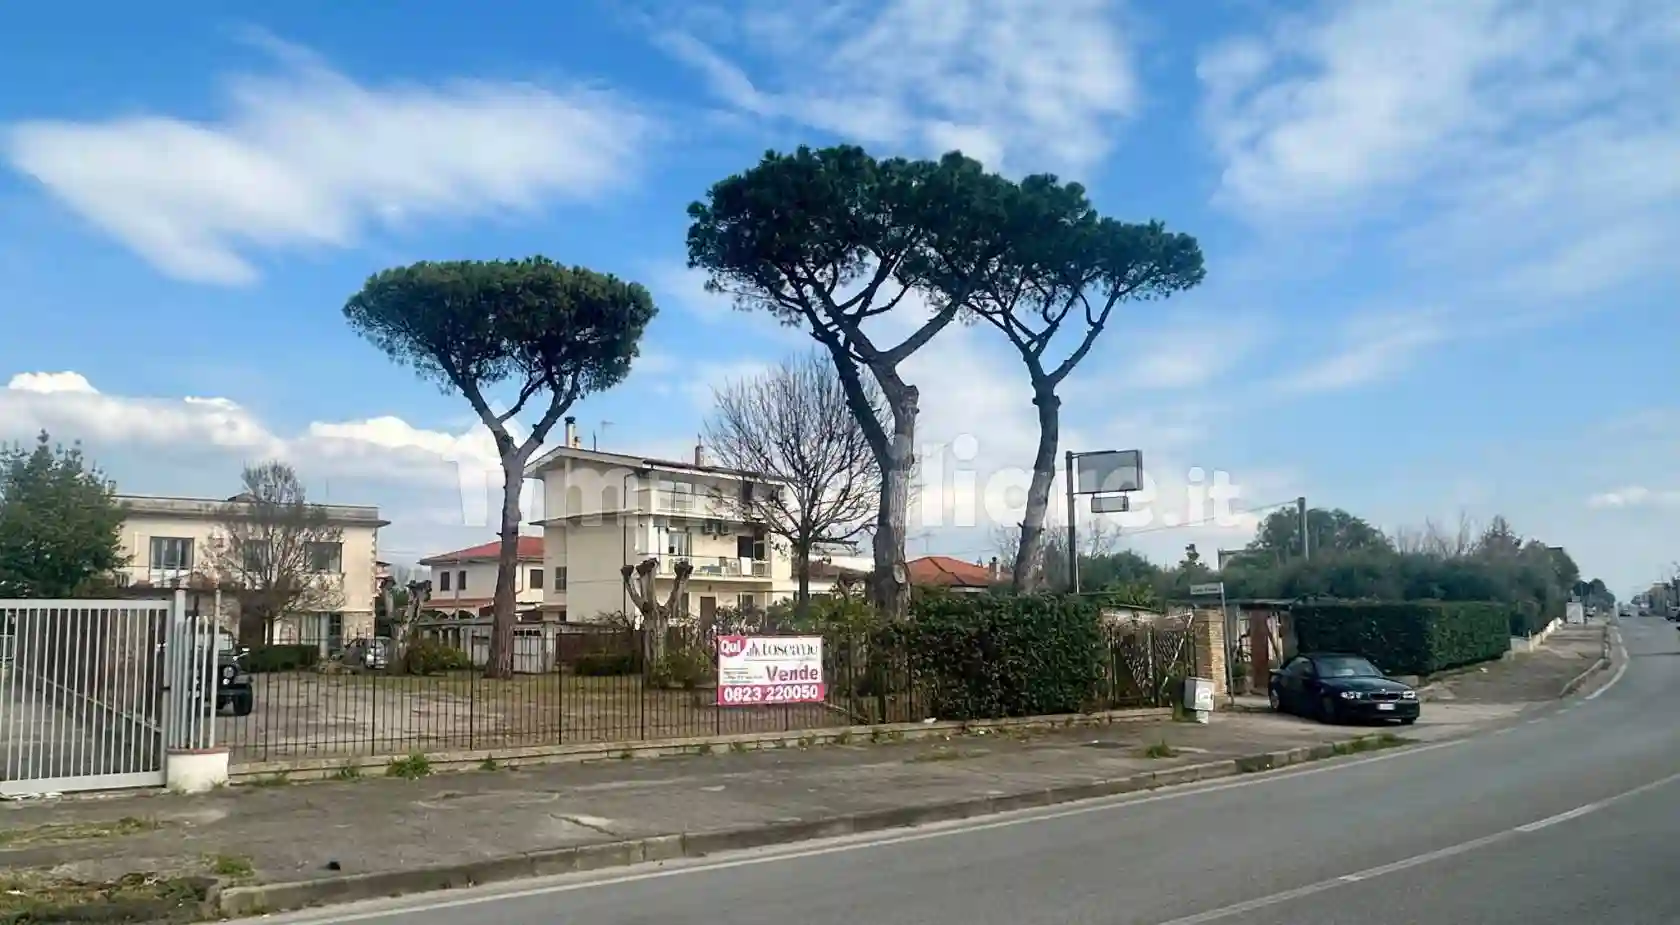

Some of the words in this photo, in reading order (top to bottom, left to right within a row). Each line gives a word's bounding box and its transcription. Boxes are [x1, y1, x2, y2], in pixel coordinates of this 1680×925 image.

[721, 639, 741, 653] Qui
[766, 664, 819, 682] Vende
[723, 685, 761, 702] 0823
[765, 684, 818, 701] 220050
